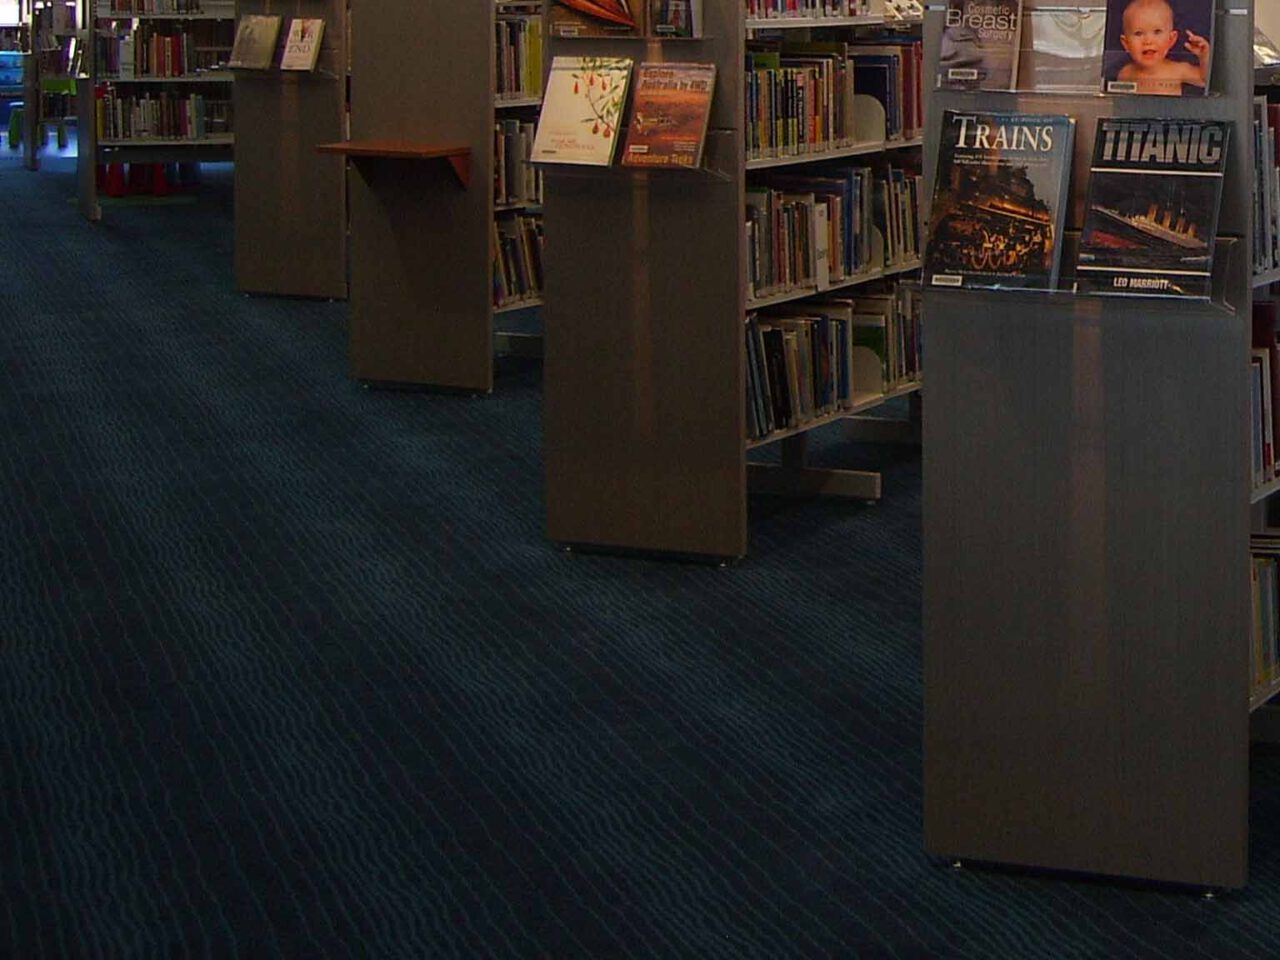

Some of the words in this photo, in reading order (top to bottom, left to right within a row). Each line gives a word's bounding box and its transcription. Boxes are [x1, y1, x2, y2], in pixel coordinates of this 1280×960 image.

[968, 3, 1010, 15] Cosmetic
[946, 8, 1017, 30] Breast
[978, 28, 1013, 40] Surgery
[952, 115, 1053, 151] TRAINS
[1102, 122, 1223, 164] TITANIC
[1113, 277, 1128, 287] LEO
[1130, 278, 1170, 290] MARRIOTT
